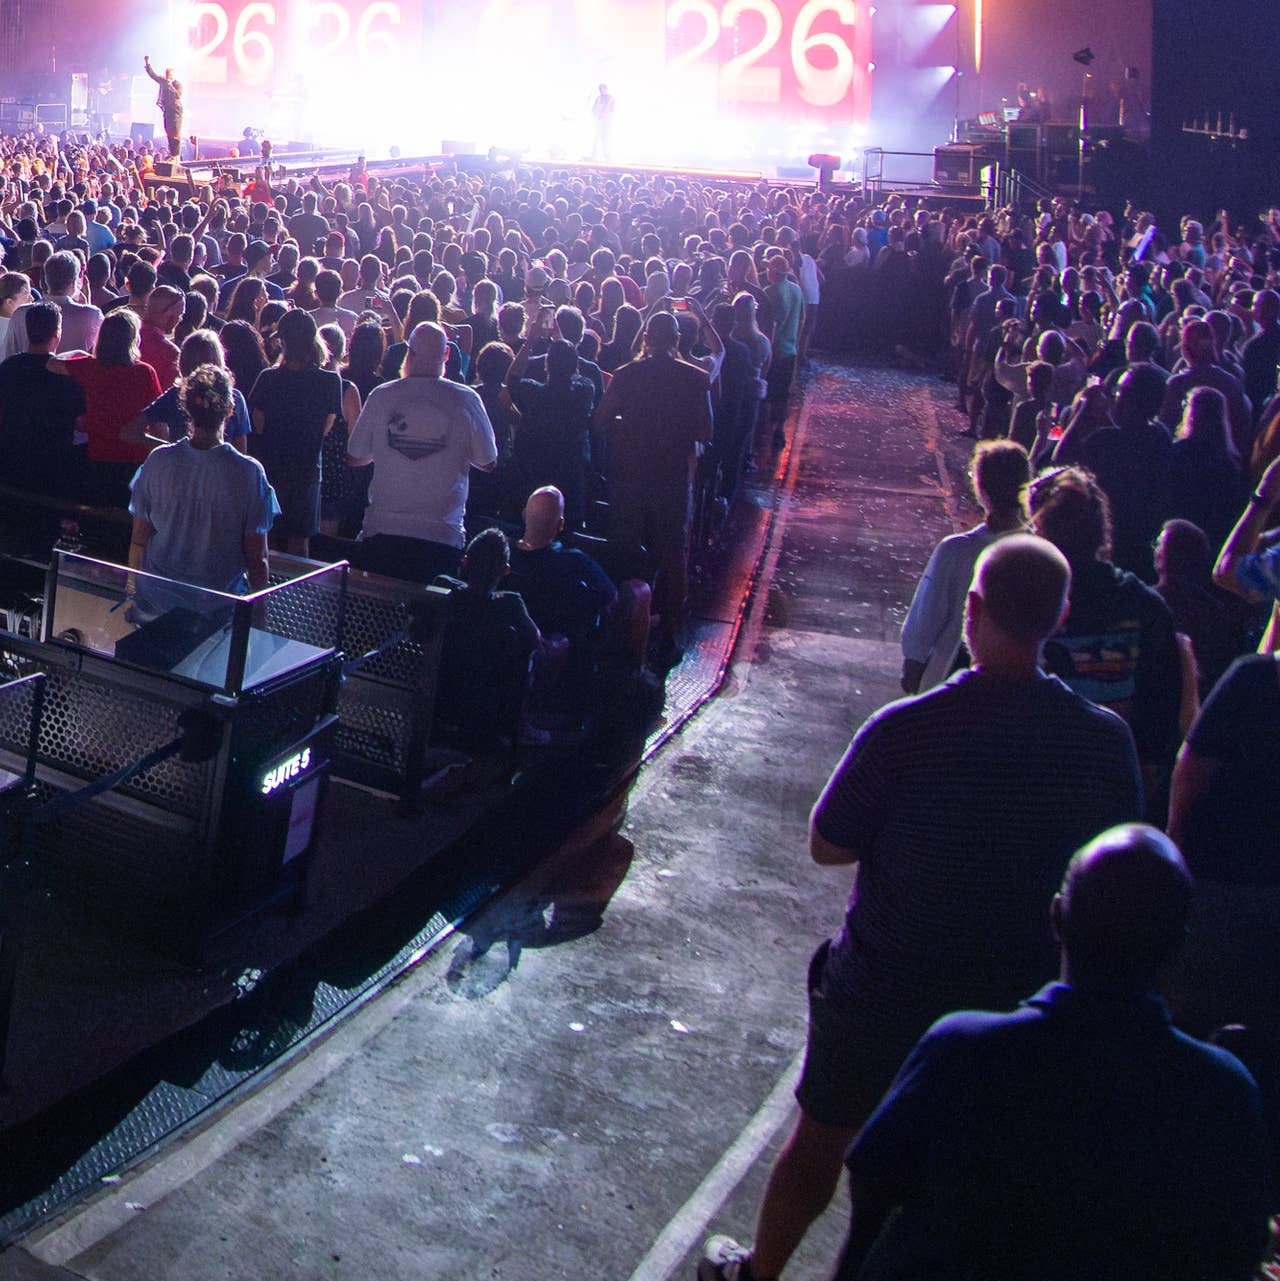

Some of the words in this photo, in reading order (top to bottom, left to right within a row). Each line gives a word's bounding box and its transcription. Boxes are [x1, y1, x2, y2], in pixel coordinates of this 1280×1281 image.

[189, 2, 277, 86] 26
[262, 753, 301, 795] SUITE
[300, 747, 311, 769] 5
